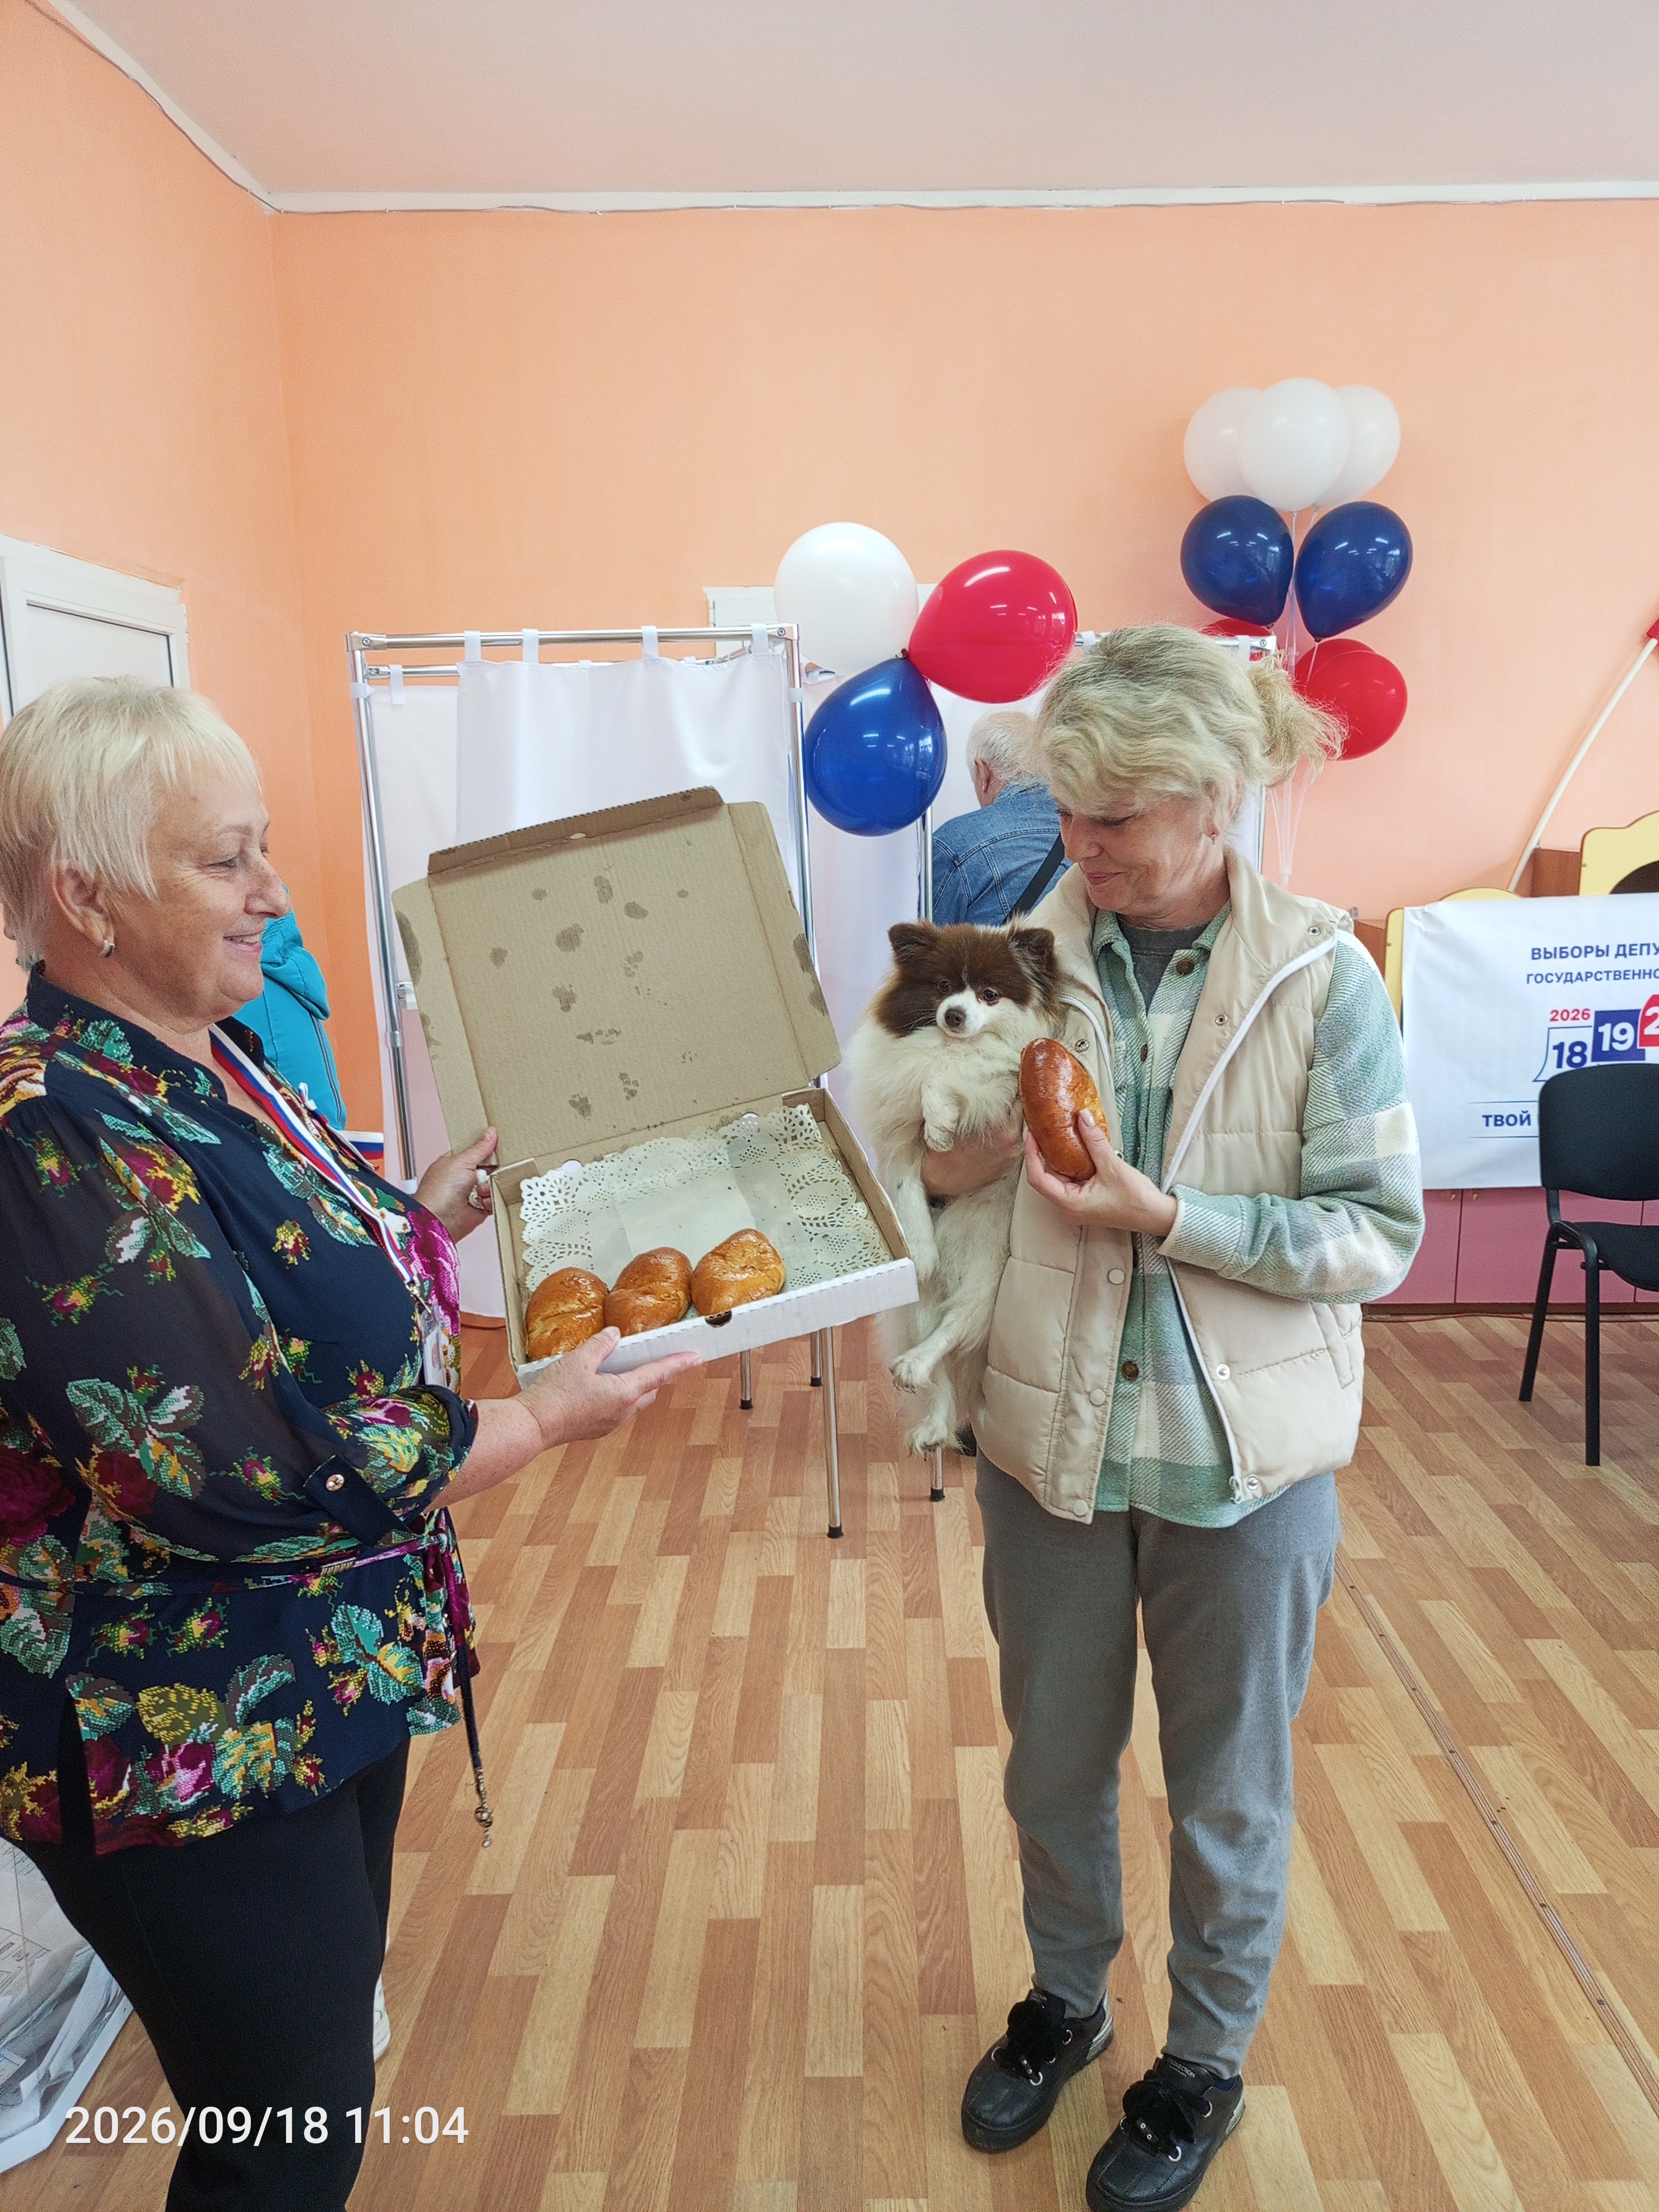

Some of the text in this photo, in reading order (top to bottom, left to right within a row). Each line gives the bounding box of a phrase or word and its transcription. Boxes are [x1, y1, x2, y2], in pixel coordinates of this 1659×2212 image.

[1531, 943, 1659, 960] ВЫБОРЫ ДЕПУ
[1526, 969, 1659, 984] ГОСУДАРСТВЕННО
[1549, 1008, 1591, 1022] 2026
[1553, 1041, 1588, 1069] 18
[1598, 1022, 1635, 1051] 19
[1482, 1110, 1531, 1127] ТВОЙ
